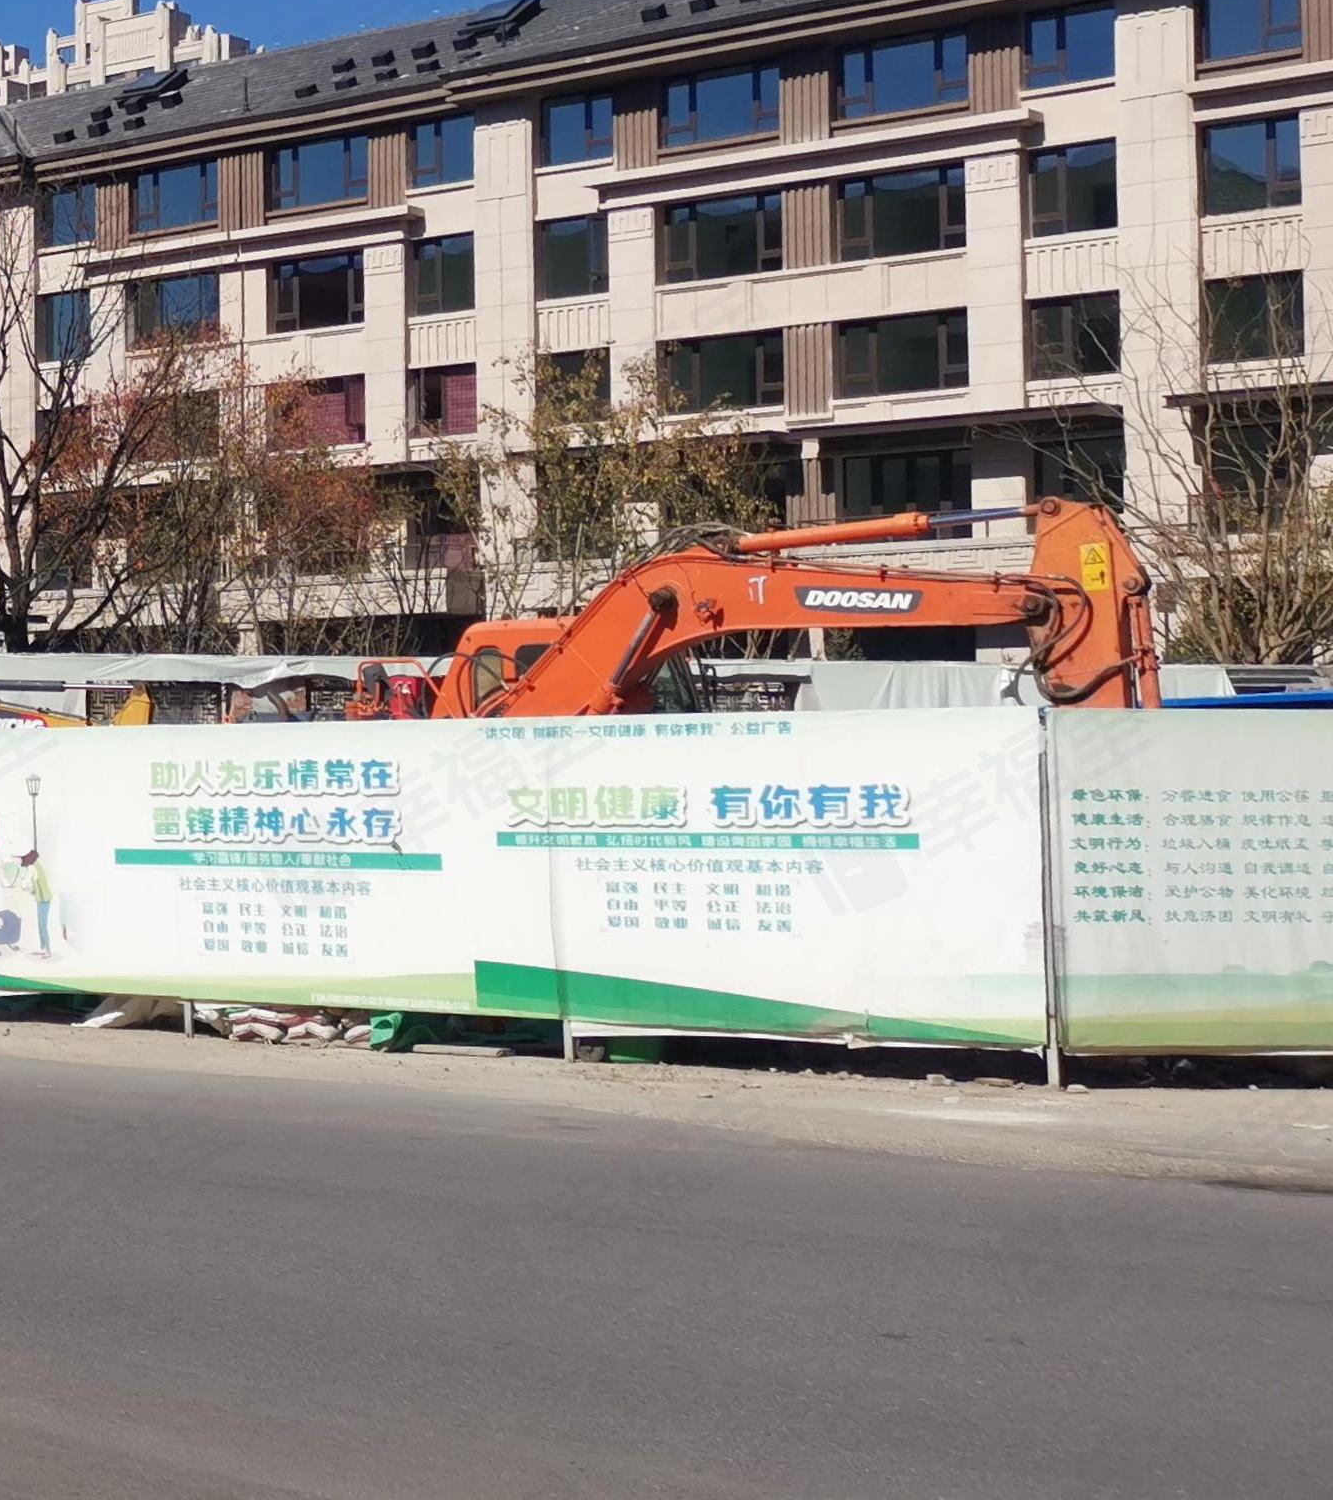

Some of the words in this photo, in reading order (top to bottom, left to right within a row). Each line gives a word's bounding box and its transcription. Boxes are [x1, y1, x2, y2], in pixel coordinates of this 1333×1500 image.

[804, 590, 913, 610] DOOSAN
[731, 720, 791, 735] 公益广告
[149, 758, 396, 792] 助人为乐情常在
[506, 785, 681, 822] 文明健康
[710, 784, 903, 821] 有你有我
[152, 806, 397, 838] 雷锋精神心永存
[574, 857, 824, 875] 社会主义核心价值观基本内容
[179, 877, 372, 897] 社会主义核心价值观基本内容
